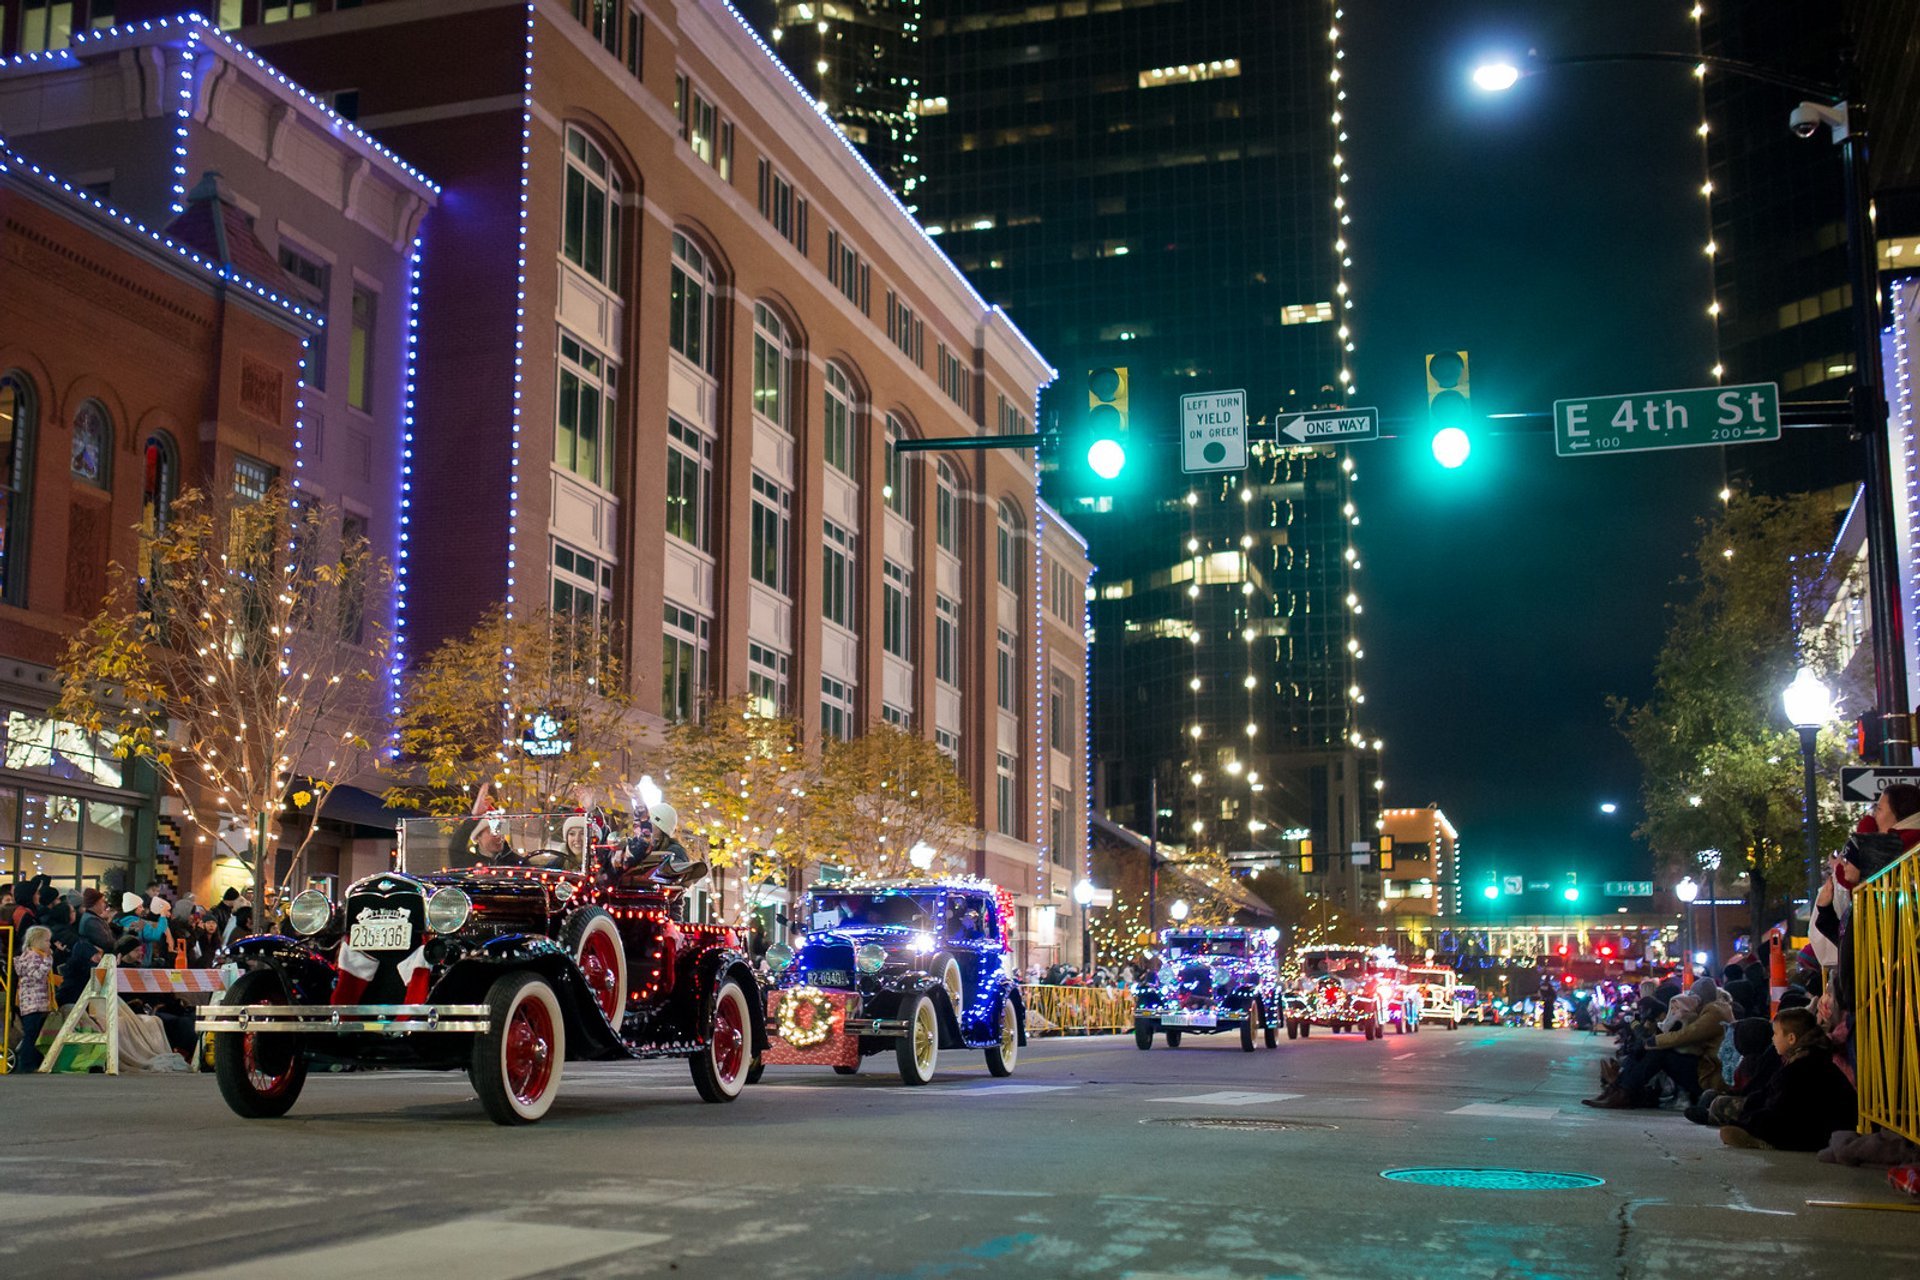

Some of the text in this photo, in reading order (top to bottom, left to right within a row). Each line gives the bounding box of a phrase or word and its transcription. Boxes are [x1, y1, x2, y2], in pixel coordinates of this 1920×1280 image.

[1187, 397, 1240, 411] LEFT TURN
[1197, 411, 1231, 425] YIELD
[1566, 391, 1766, 437] E 4th St
[1189, 427, 1239, 439] ON GREEN
[1306, 418, 1366, 434] ONE WAY
[1711, 428, 1741, 439] 200
[1595, 437, 1620, 448] 100
[352, 927, 375, 947] 235
